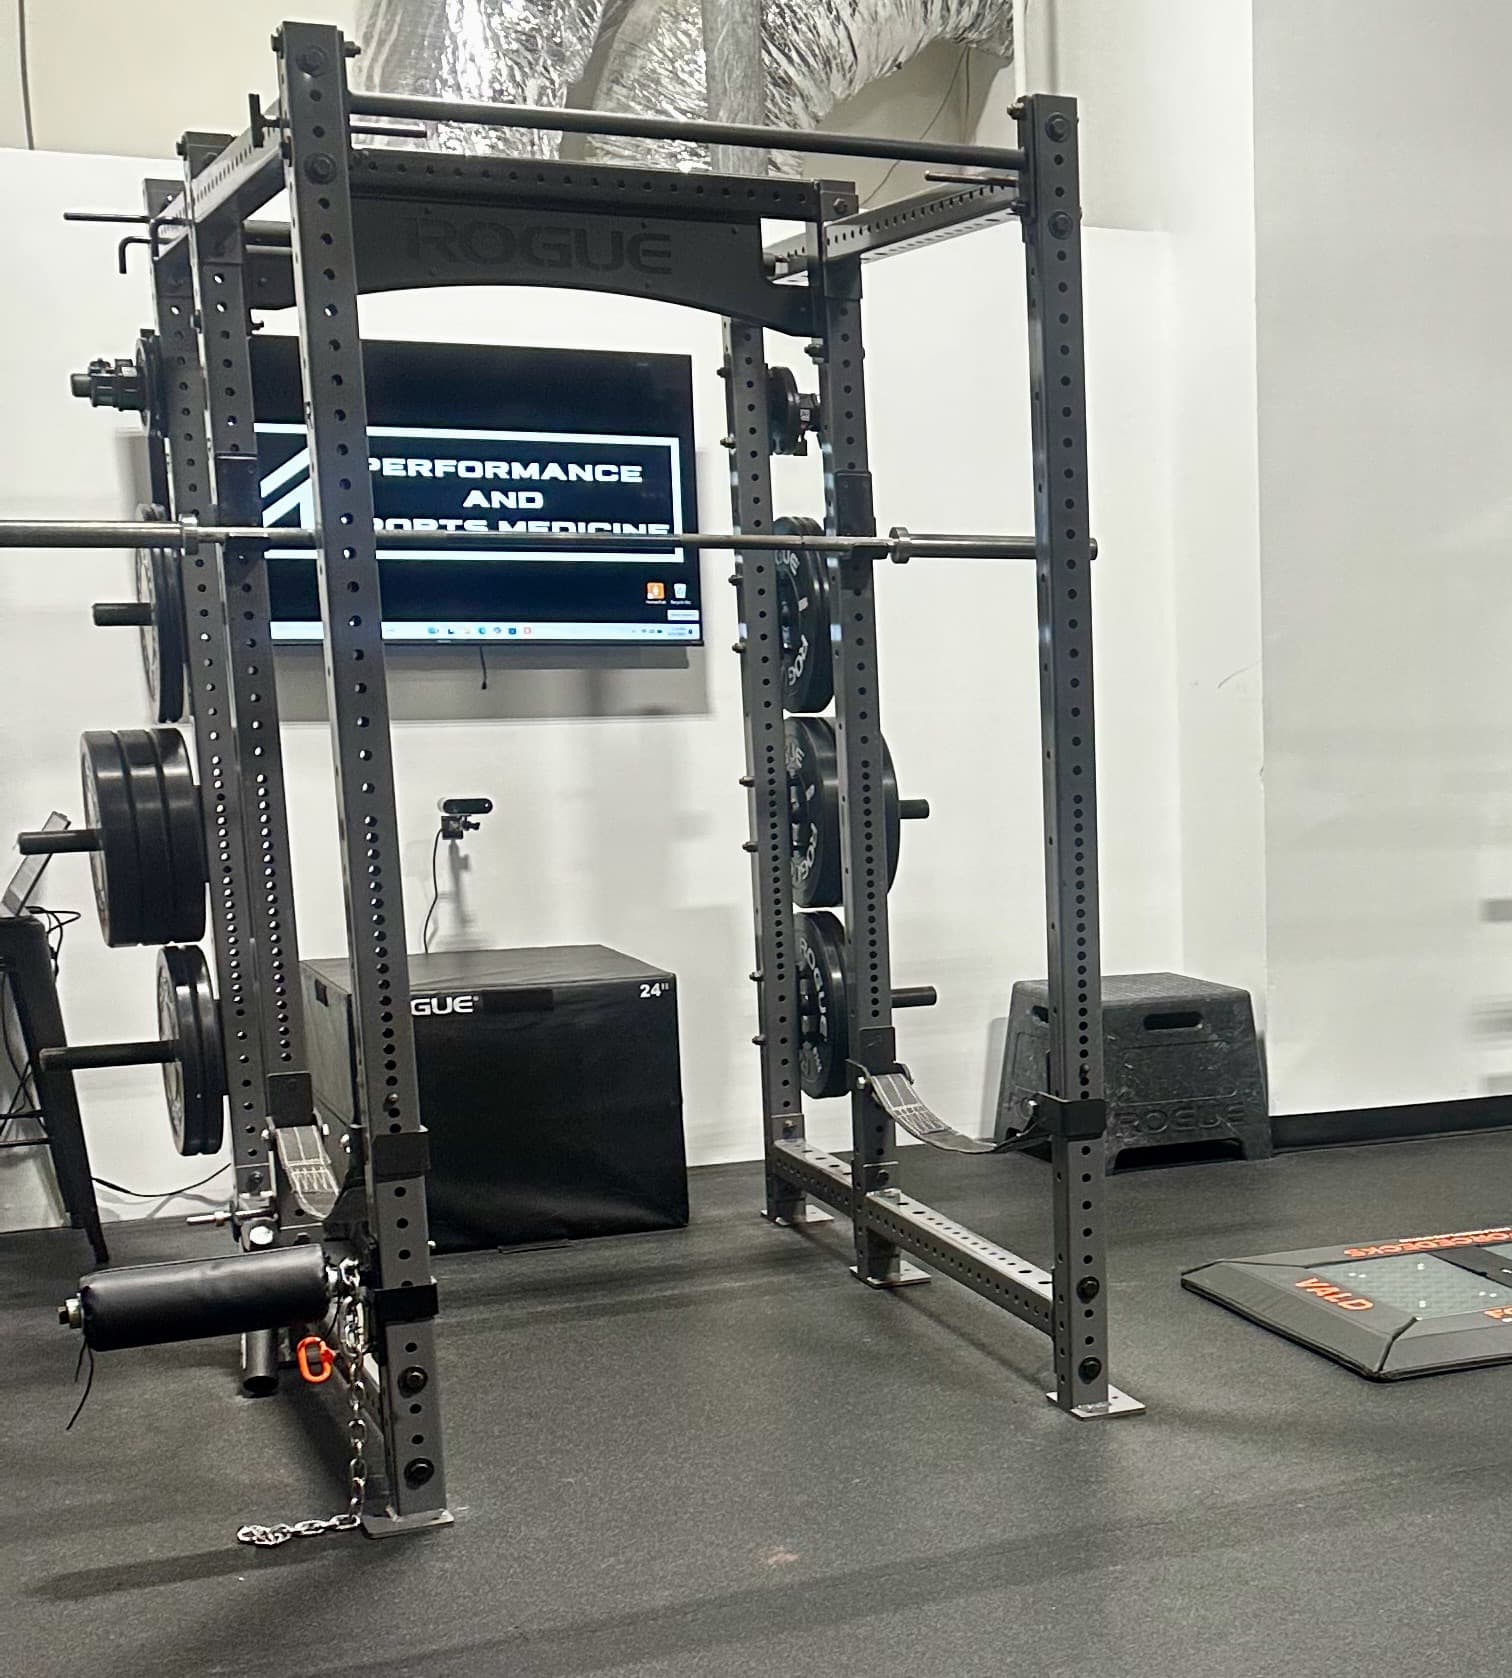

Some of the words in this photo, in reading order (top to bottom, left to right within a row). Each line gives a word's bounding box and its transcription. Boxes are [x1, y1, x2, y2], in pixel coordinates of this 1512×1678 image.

[405, 216, 673, 275] ROGUE
[367, 457, 643, 483] PERFORMANCE
[463, 490, 544, 510] AND
[372, 518, 488, 533] ORTS
[788, 634, 808, 686] ROG
[410, 996, 475, 1016] GUE
[1295, 1277, 1374, 1311] VALD
